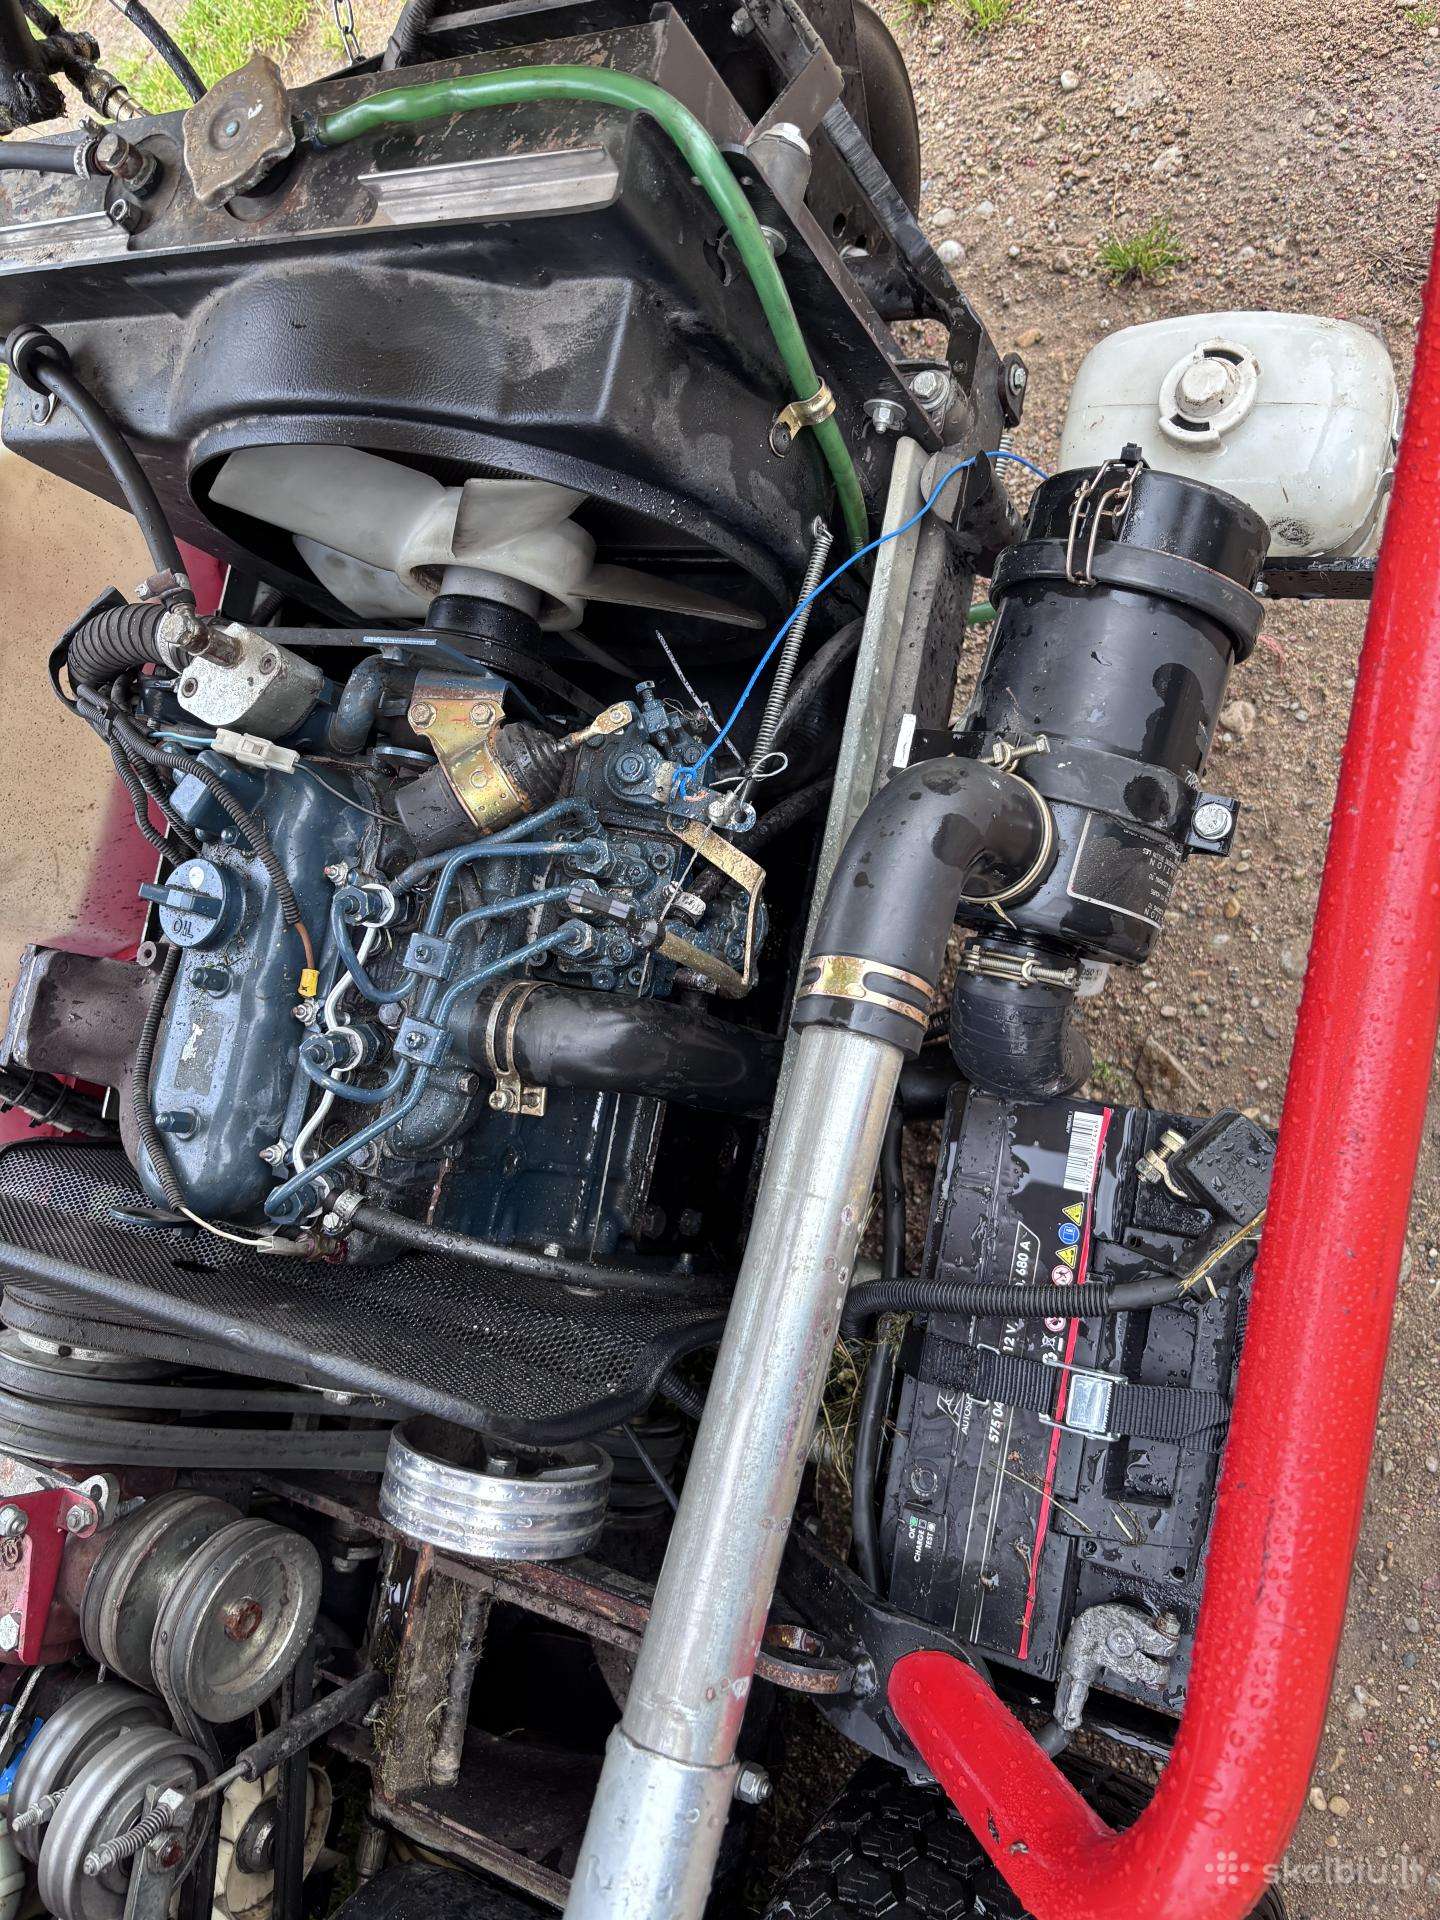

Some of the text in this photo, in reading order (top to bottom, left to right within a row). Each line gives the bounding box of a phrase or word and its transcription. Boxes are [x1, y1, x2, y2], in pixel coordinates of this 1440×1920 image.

[172, 918, 194, 939] OIL
[1019, 1239, 1032, 1252] A
[1015, 1251, 1030, 1276] 680
[1002, 1335, 1017, 1352] 12
[961, 1398, 973, 1436] AUTOSE
[993, 1400, 1005, 1418] 04
[988, 1418, 1004, 1443] 575
[908, 1525, 916, 1539] OK
[924, 1531, 934, 1549] TEST
[913, 1529, 925, 1563] CHARGE
